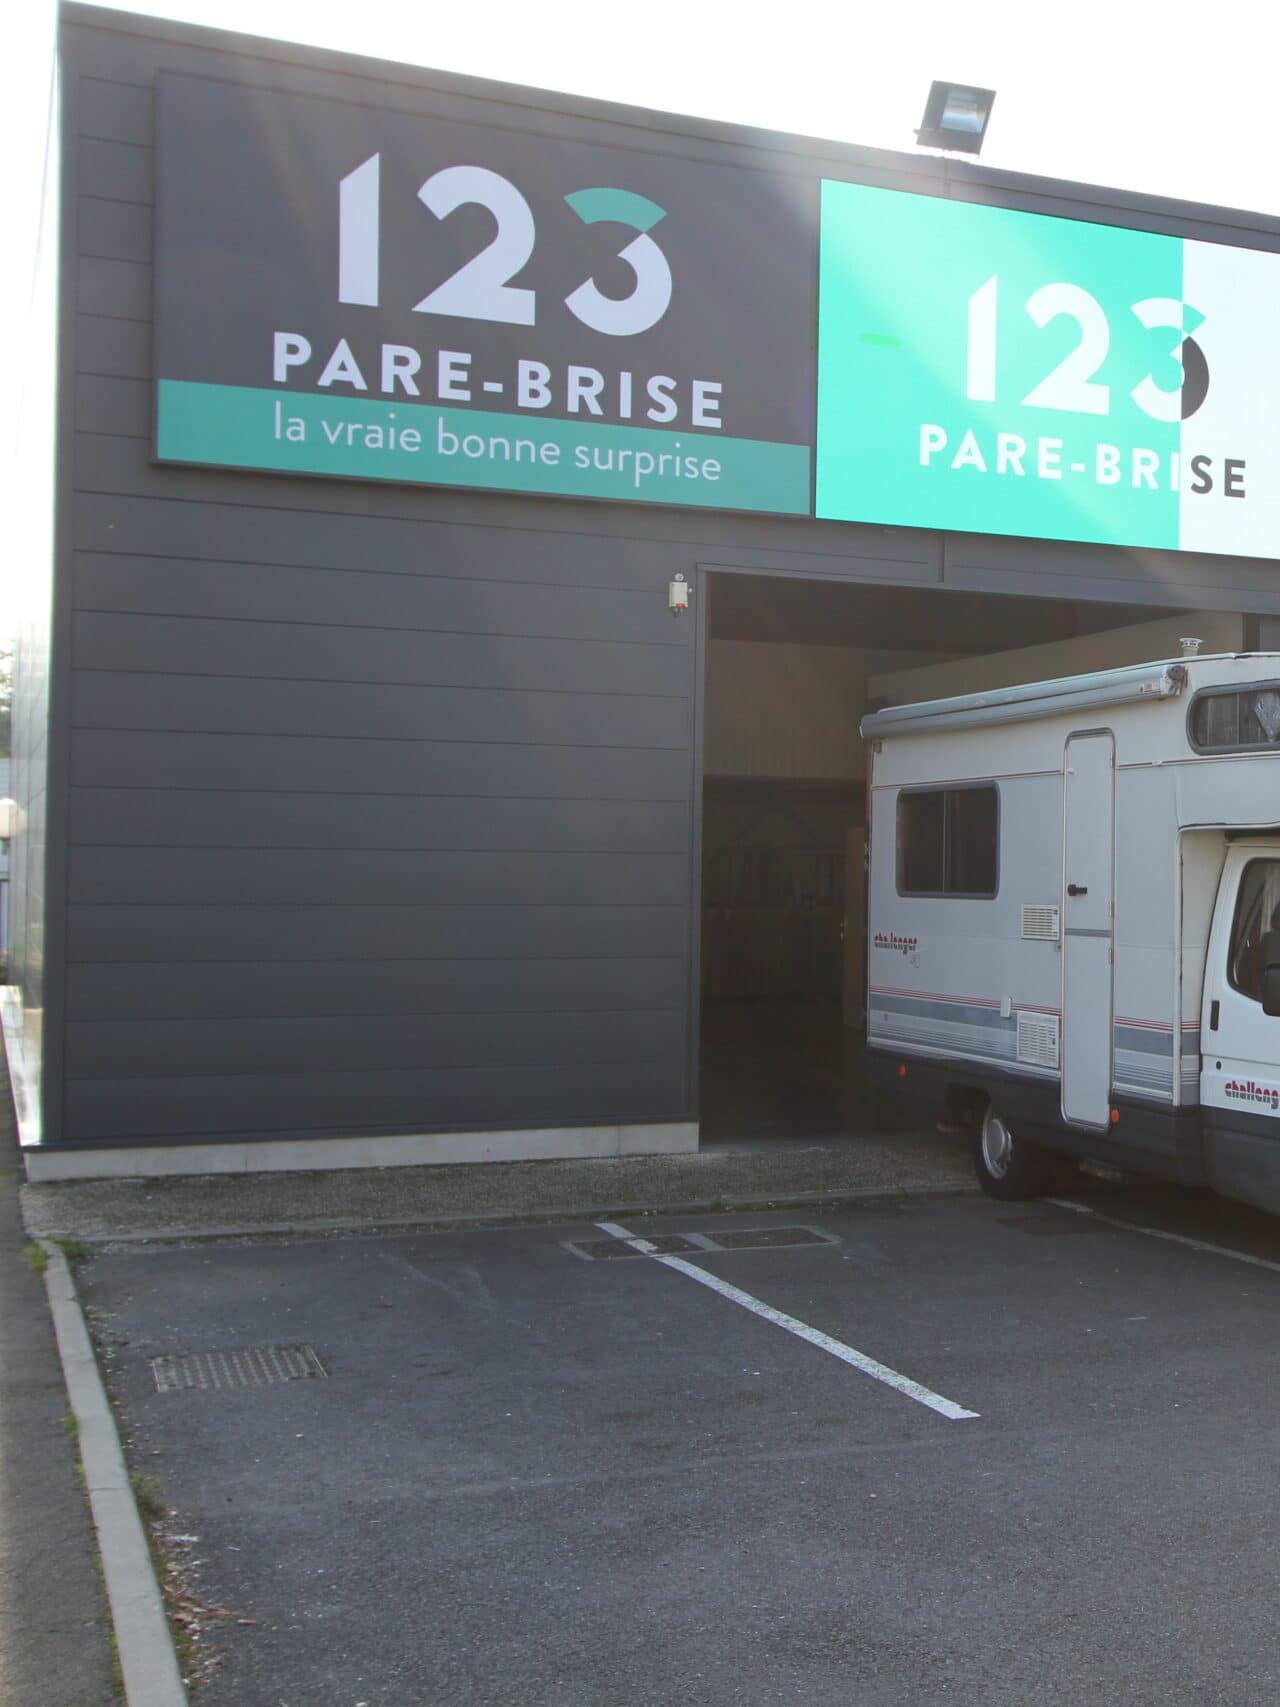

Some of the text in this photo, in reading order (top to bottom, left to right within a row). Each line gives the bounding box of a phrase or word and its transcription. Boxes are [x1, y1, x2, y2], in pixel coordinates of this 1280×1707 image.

[339, 152, 672, 336] 123
[273, 331, 723, 429] PARE-BRISE
[967, 273, 1210, 423] 123
[274, 400, 722, 488] la vraie bonne surprise
[919, 424, 1246, 499] PARE-BRISE
